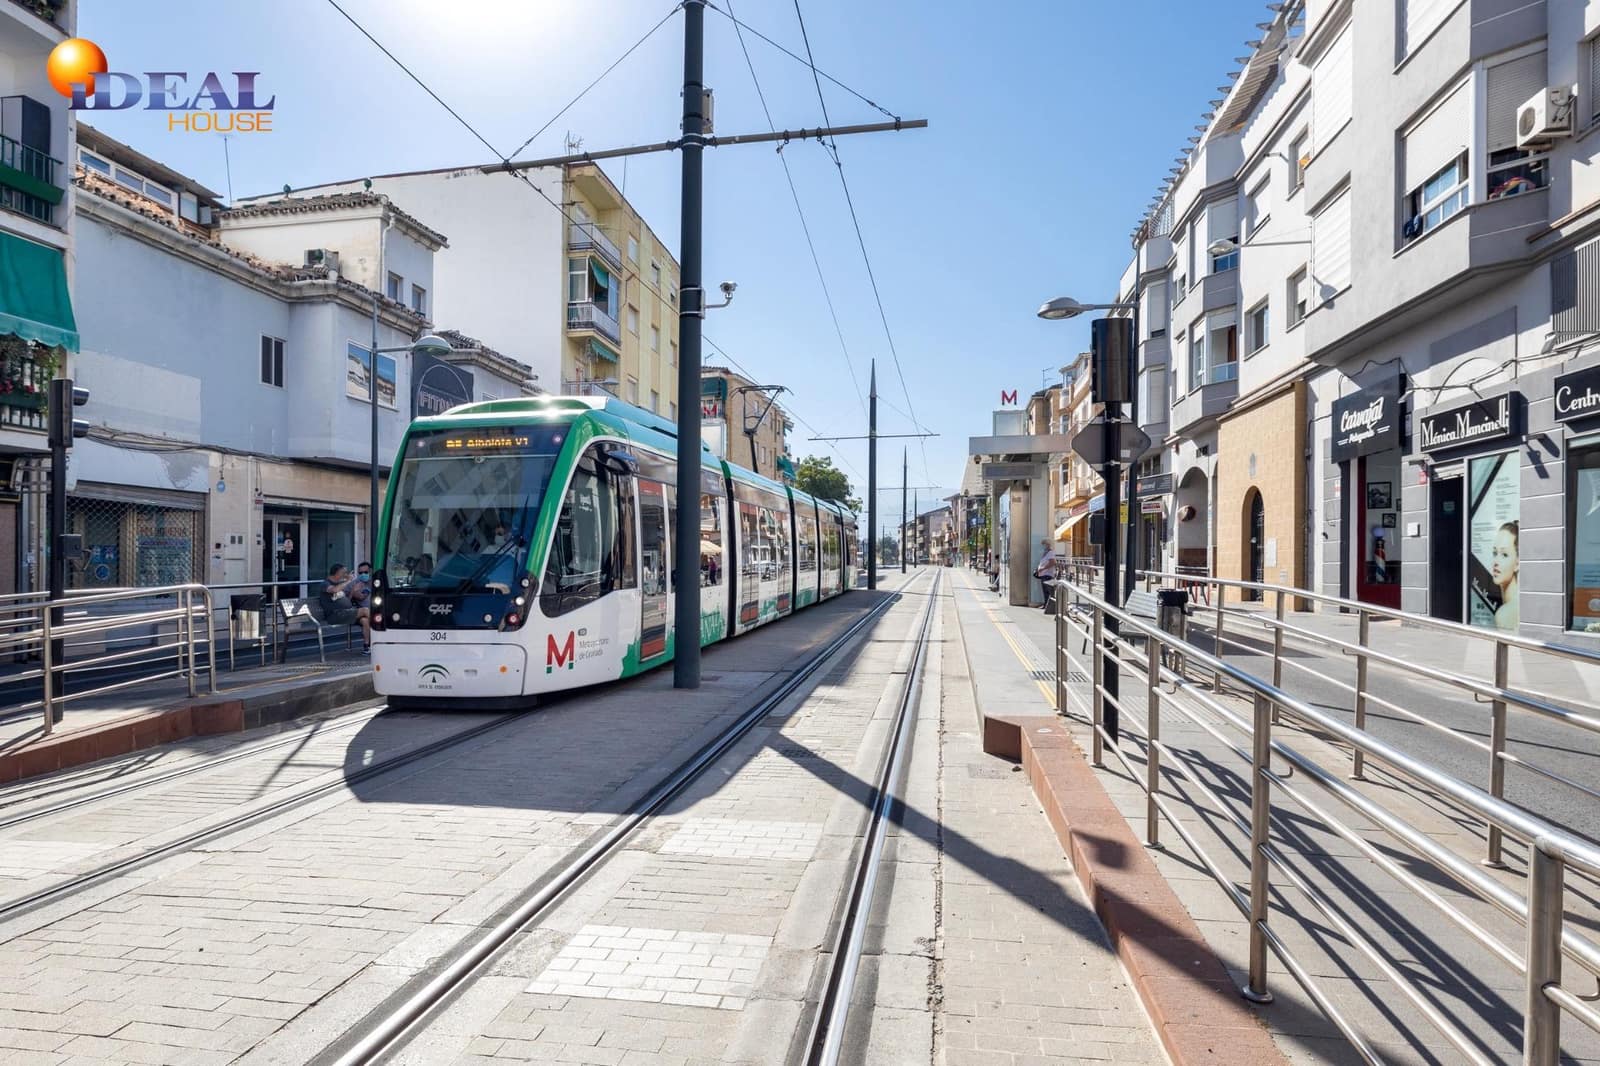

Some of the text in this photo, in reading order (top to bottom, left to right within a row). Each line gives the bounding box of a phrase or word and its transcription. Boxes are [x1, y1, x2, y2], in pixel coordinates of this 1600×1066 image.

[1001, 389, 1017, 406] M
[1341, 396, 1384, 432] Carvajal
[1455, 397, 1509, 439] Mancinelli
[428, 603, 453, 616] CAF
[430, 631, 447, 641] 304
[546, 630, 575, 674] M
